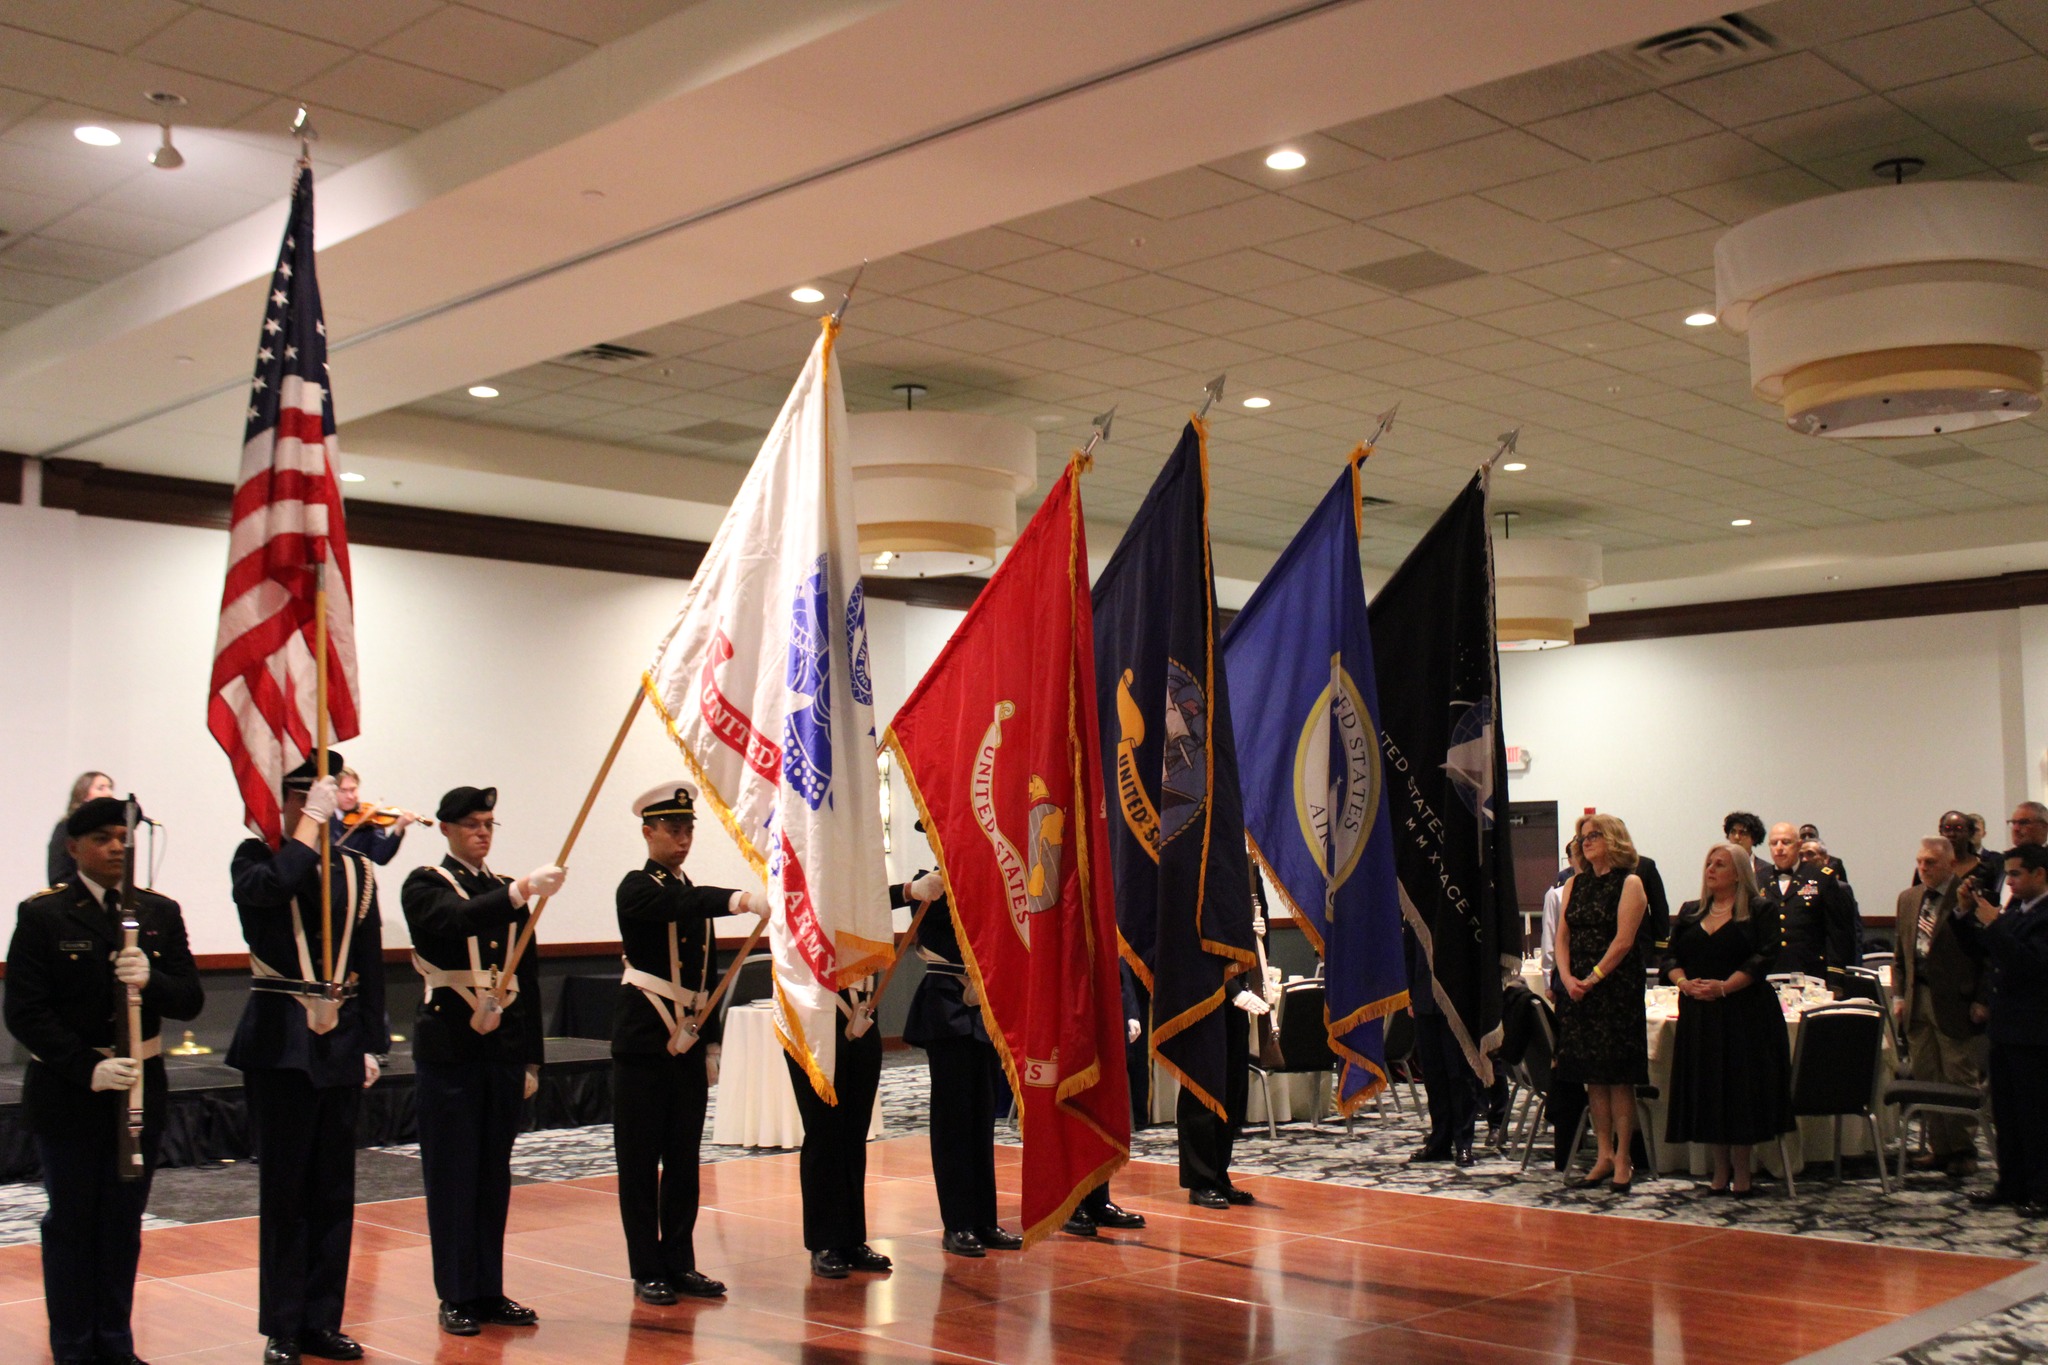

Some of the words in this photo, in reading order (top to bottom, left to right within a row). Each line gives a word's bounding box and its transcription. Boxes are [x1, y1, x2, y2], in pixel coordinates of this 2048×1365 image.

[702, 681, 776, 769] UNITED
[1381, 730, 1409, 772] TED
[1119, 753, 1148, 822] UNITED
[1344, 736, 1367, 833] STATES
[975, 746, 995, 833] UNITED
[994, 841, 1030, 925] STATES
[784, 890, 837, 979] ARMY
